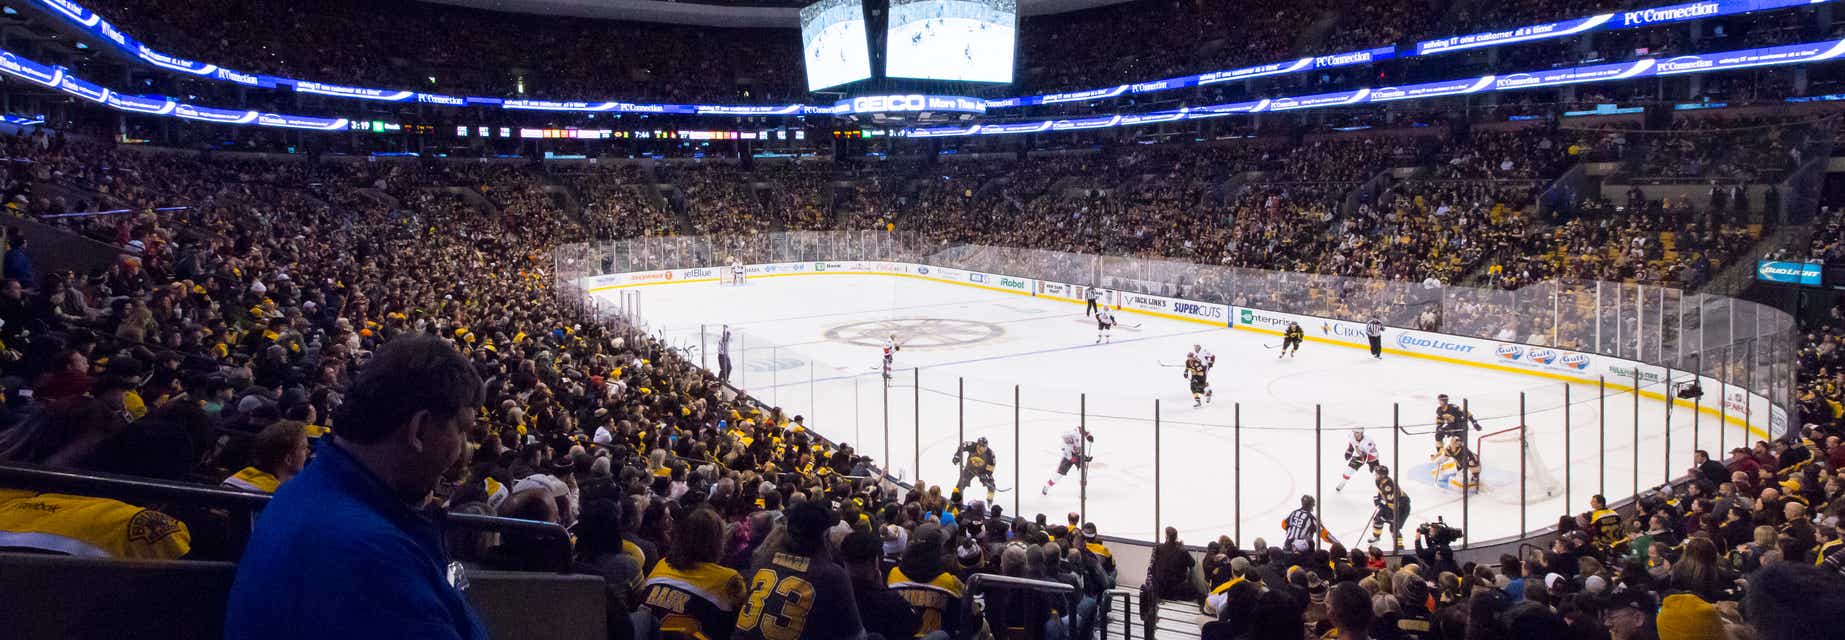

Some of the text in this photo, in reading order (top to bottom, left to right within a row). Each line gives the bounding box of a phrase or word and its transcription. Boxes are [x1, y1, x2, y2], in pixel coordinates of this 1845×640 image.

[1624, 3, 1719, 25] PC Connection
[1423, 39, 1449, 49] solving
[1450, 36, 1458, 45] IT
[1460, 35, 1475, 44] one
[1476, 30, 1514, 42] customer
[1316, 51, 1370, 68] PC Connection
[1657, 59, 1713, 72] PC Connection
[418, 93, 463, 105] PC Connection
[854, 94, 925, 113] GEICO
[929, 97, 956, 109] More
[958, 98, 976, 110] Than
[620, 103, 663, 112] PC Connection
[804, 106, 813, 114] PC
[351, 121, 370, 130] 3:19
[684, 268, 712, 280] jetBlue
[1765, 266, 1820, 277] BUD LIGHT
[1000, 278, 1025, 290] iRobot
[1135, 296, 1147, 305] JACK
[1174, 302, 1221, 319] SUPERCUTS
[1401, 335, 1474, 353] BUD LIGHT
[1498, 345, 1518, 353] Gulf
[1530, 350, 1550, 358] Gulf
[736, 568, 816, 640] 33
